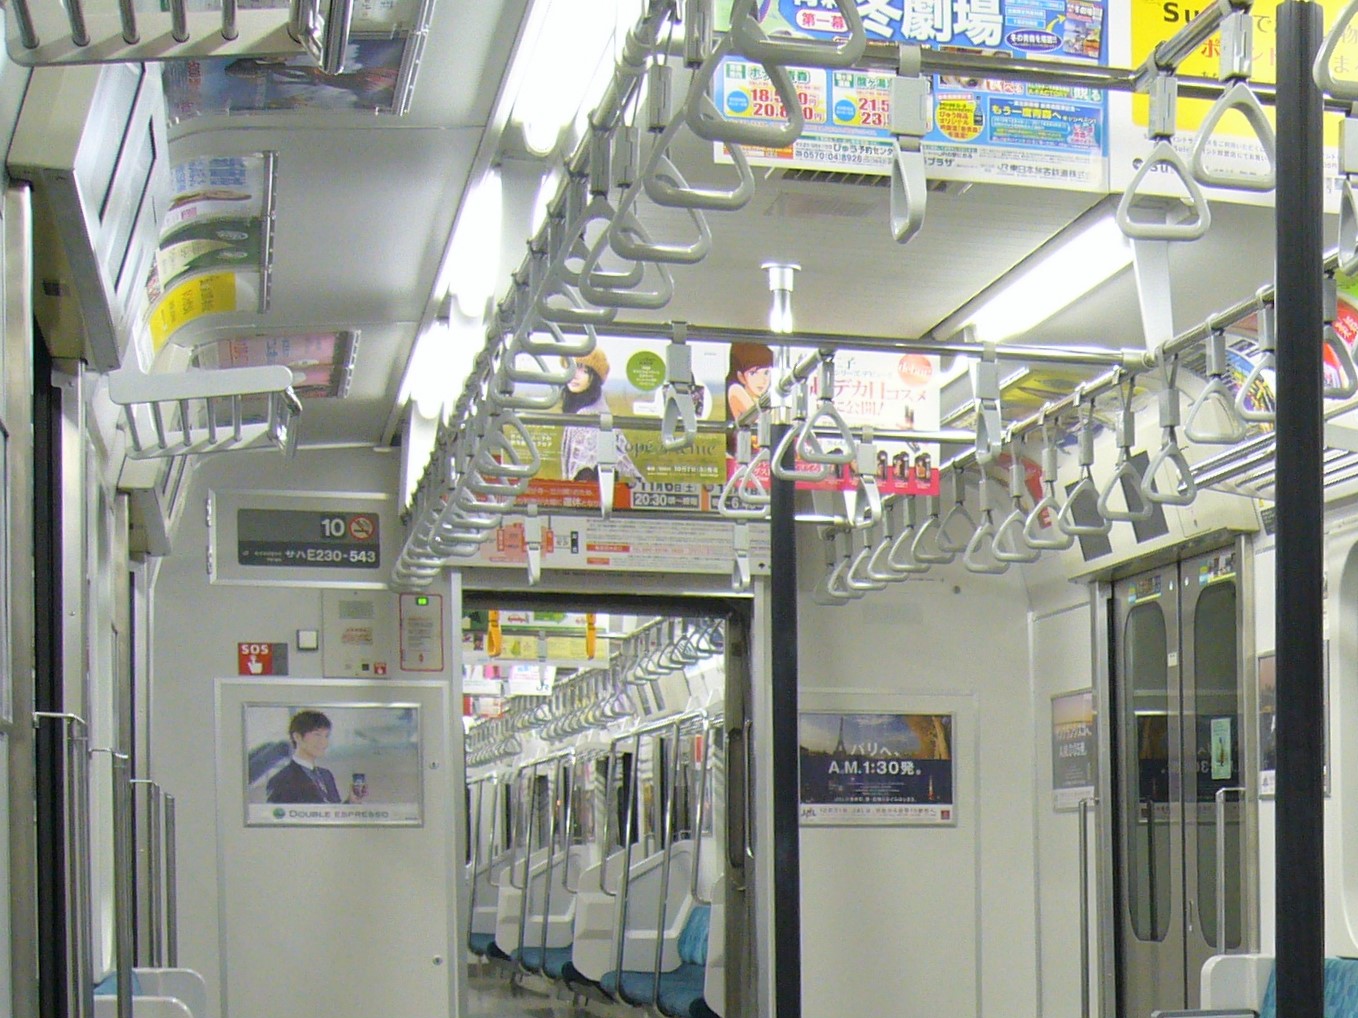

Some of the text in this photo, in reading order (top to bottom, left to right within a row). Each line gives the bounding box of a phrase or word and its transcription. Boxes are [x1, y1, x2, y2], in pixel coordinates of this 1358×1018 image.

[321, 518, 346, 537] 10
[285, 549, 376, 563] サハE230-543
[241, 644, 269, 655] SOS
[828, 760, 921, 776] A.M.1:30発。
[288, 809, 331, 819] DOUBLE
